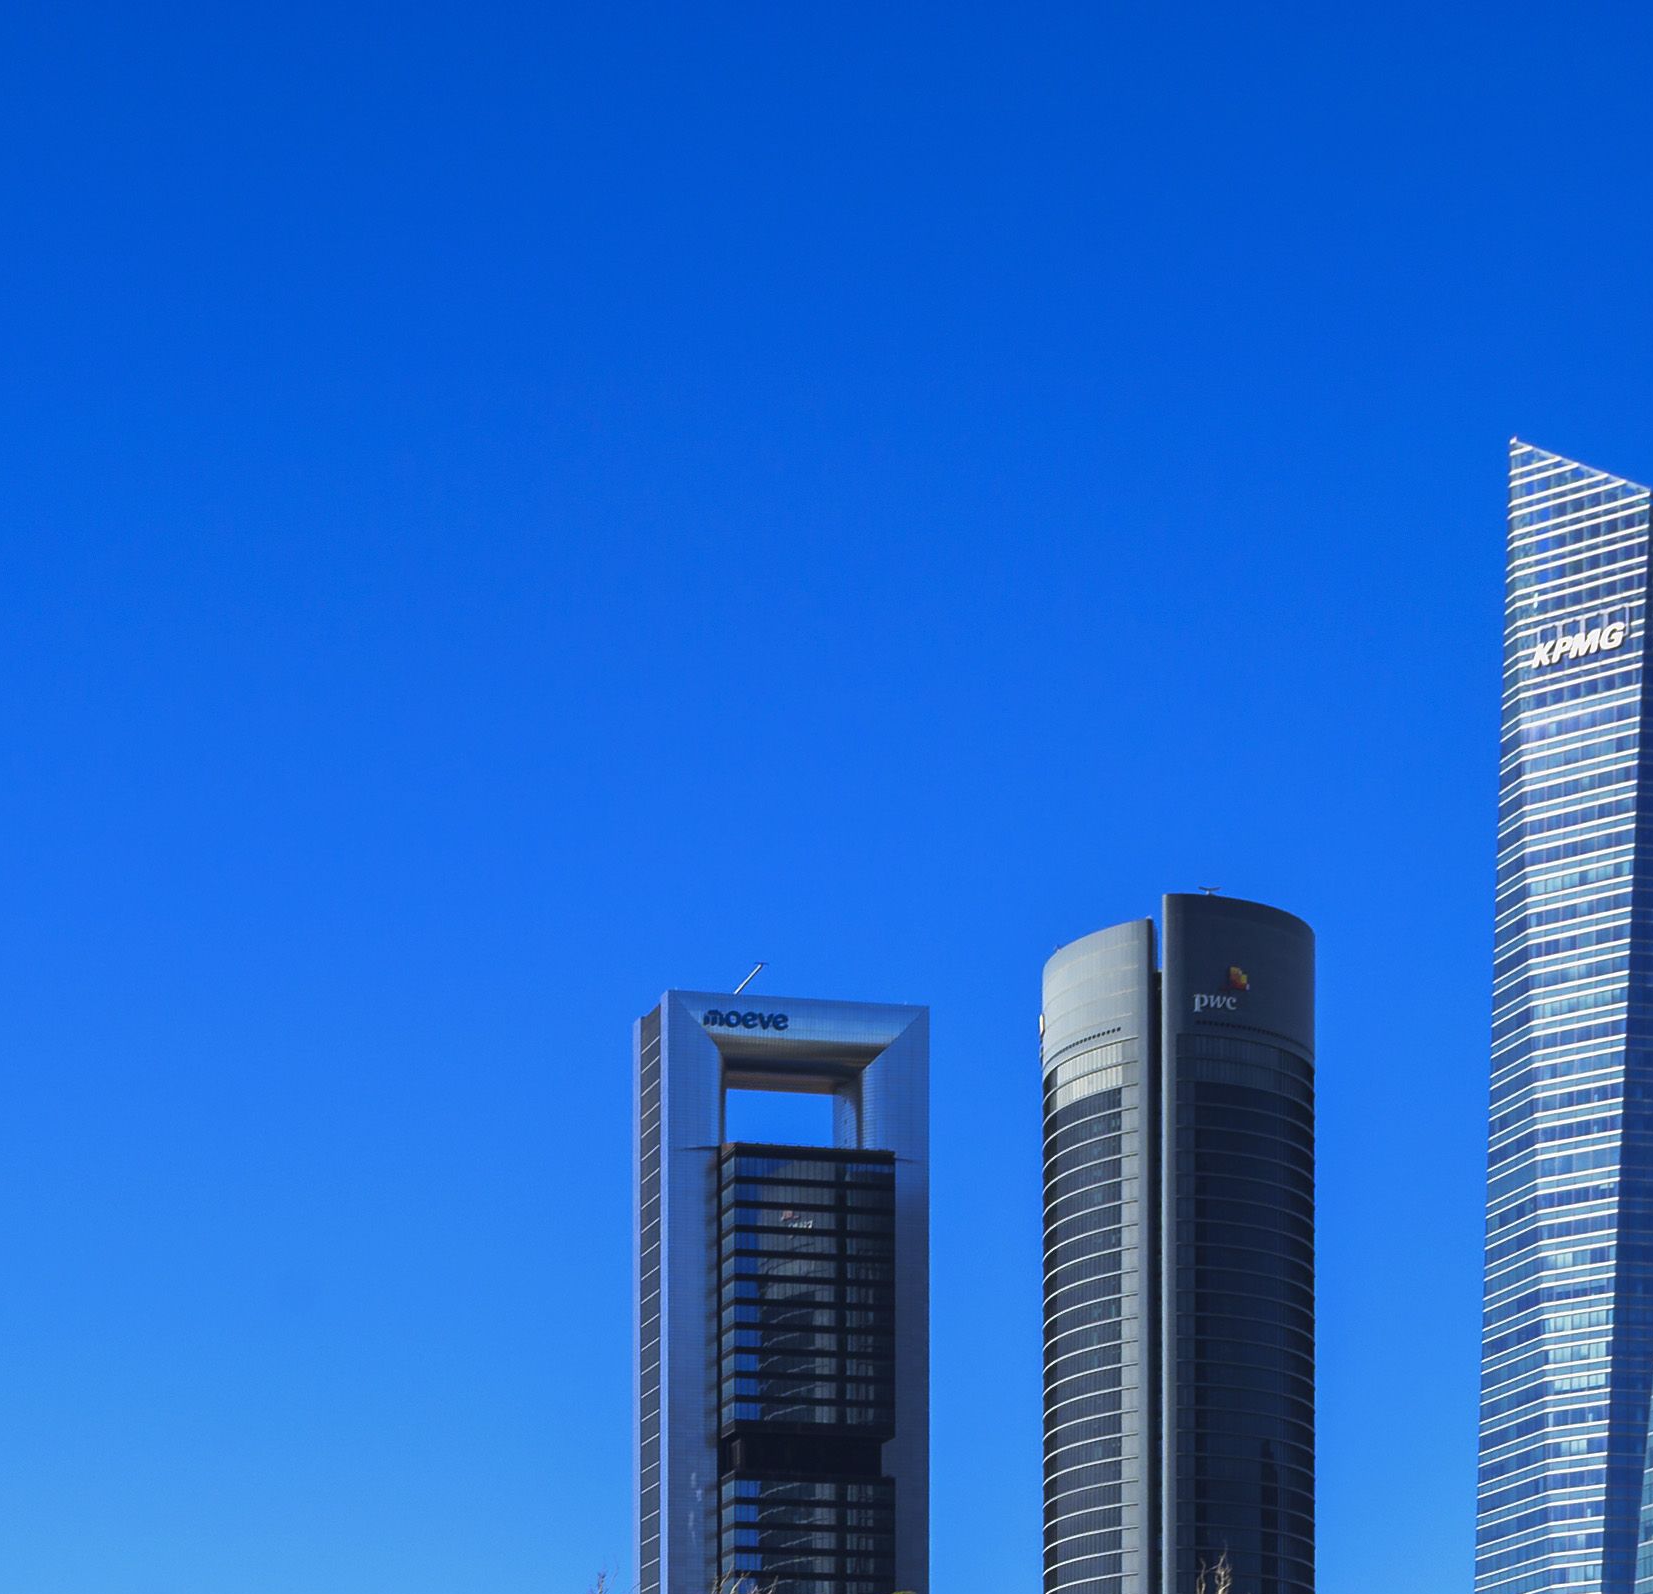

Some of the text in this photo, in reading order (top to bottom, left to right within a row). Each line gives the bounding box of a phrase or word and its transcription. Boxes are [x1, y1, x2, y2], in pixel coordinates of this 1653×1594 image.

[1532, 621, 1626, 669] KPMG
[1193, 993, 1238, 1013] pwc
[702, 1008, 789, 1031] moeve
